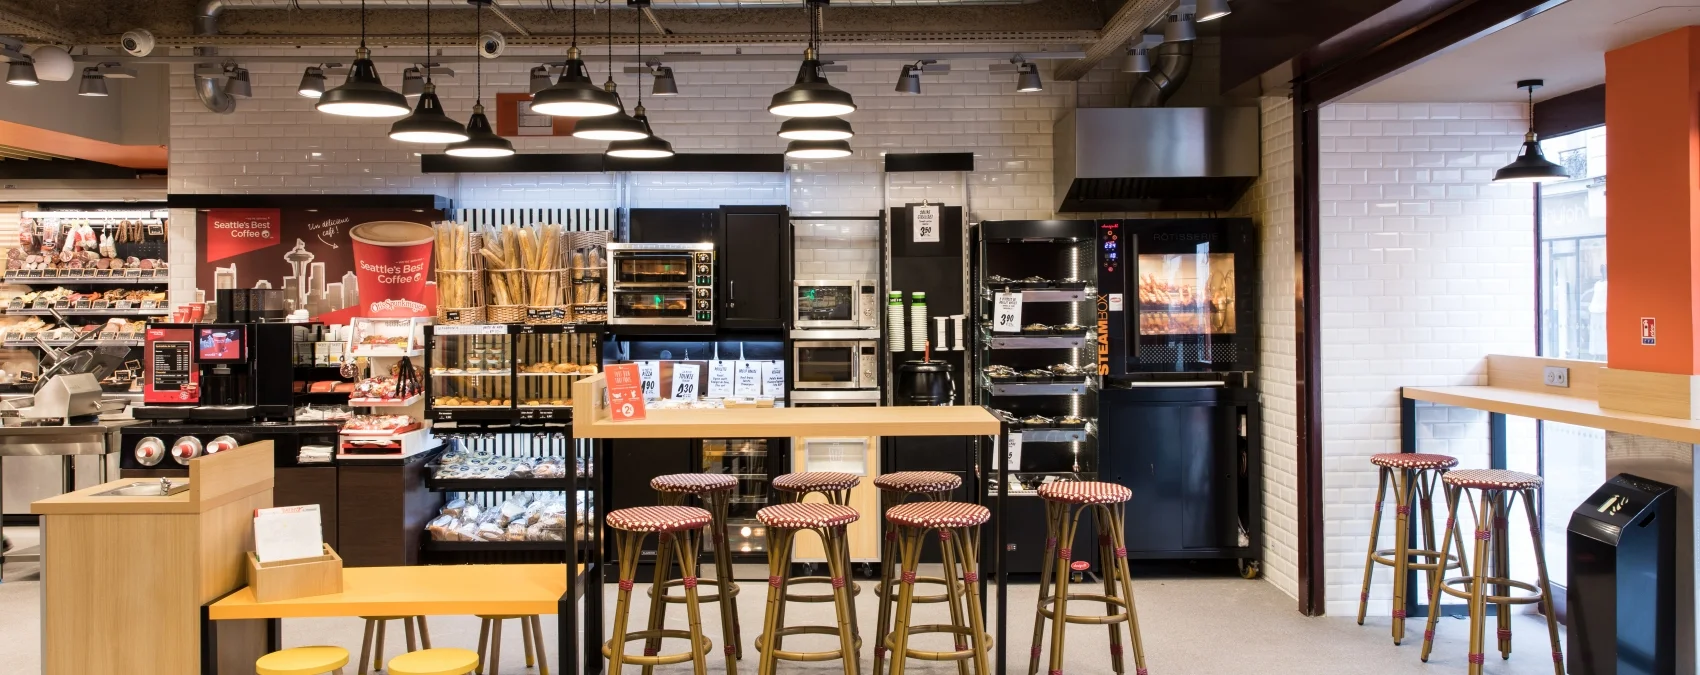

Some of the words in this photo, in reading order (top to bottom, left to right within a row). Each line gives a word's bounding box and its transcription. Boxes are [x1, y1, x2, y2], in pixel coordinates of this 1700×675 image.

[213, 221, 250, 229] Seattle's
[251, 221, 271, 229] Best
[231, 230, 260, 238] Coffee
[360, 260, 401, 274] Seattle's
[403, 262, 424, 274] Best
[377, 274, 413, 284] Coffee
